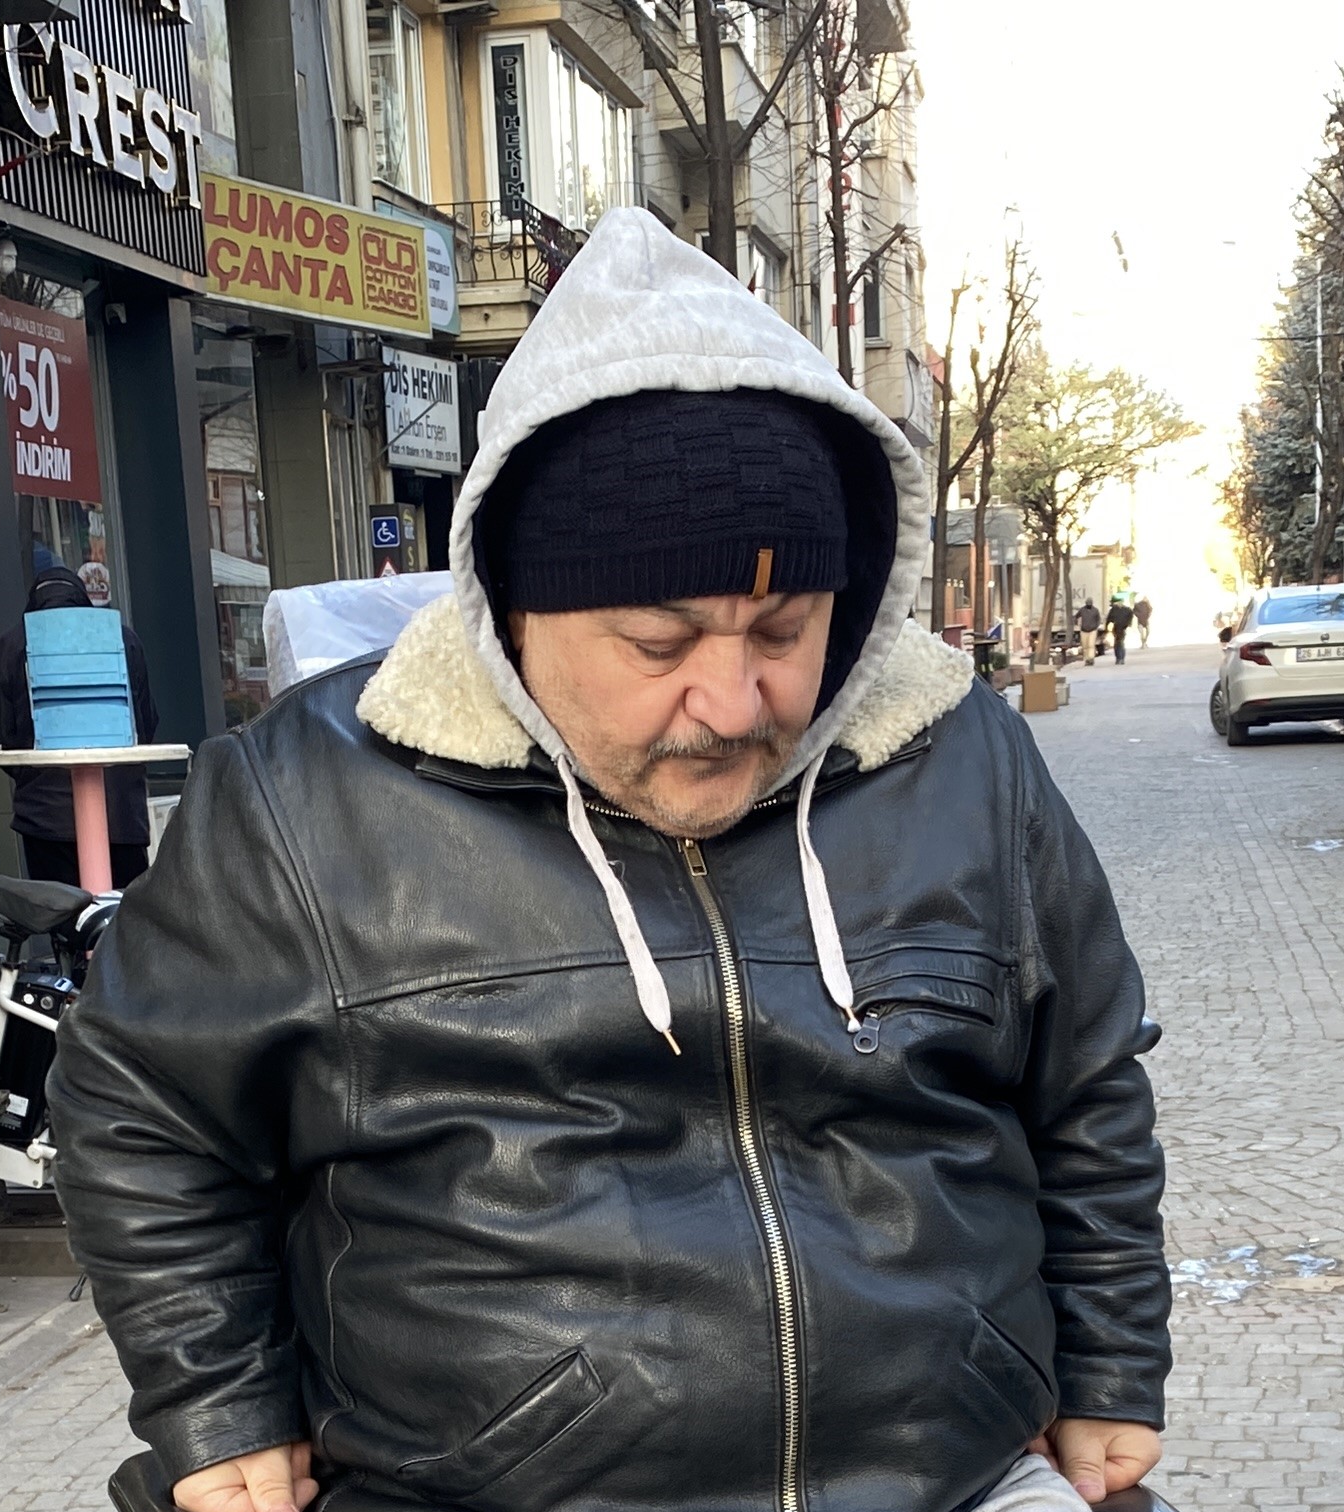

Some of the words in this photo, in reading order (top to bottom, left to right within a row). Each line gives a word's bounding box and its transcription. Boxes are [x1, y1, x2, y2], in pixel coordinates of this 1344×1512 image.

[3, 23, 202, 210] CREST
[204, 182, 350, 256] LUMOS
[207, 237, 354, 306] ÇANTA
[362, 232, 416, 276] OLD
[364, 265, 417, 294] COTTON
[367, 286, 418, 312] CARGO
[390, 353, 409, 404] DİŞ
[411, 362, 453, 405] HEKİMİ
[16, 430, 71, 482] İNDİRİM
